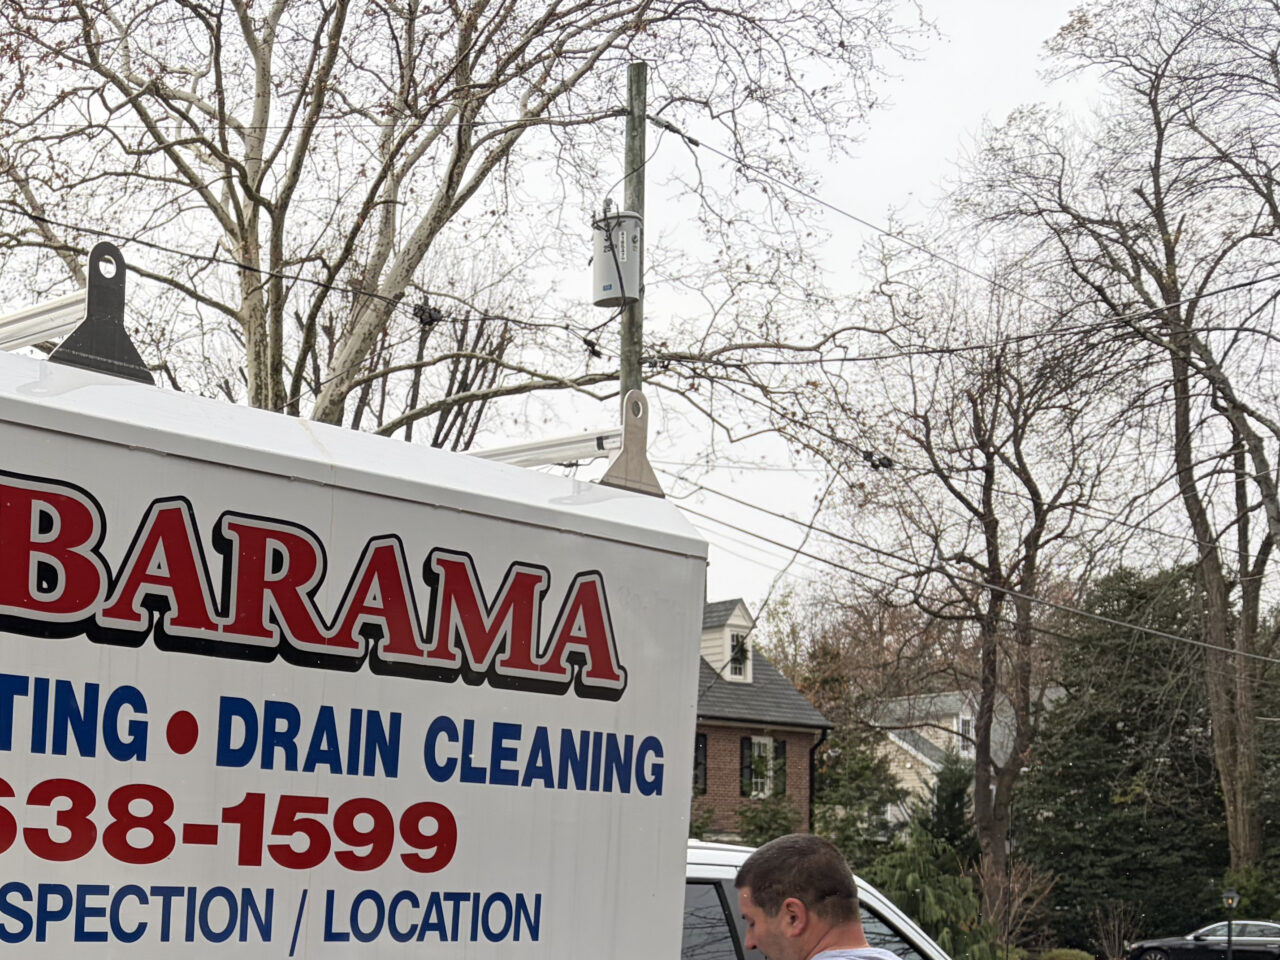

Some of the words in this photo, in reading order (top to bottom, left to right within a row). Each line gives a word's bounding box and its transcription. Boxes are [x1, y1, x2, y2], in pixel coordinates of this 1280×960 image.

[217, 694, 402, 778] DRAIN
[423, 716, 665, 796] CLEANING
[322, 890, 541, 943] LOCATION
